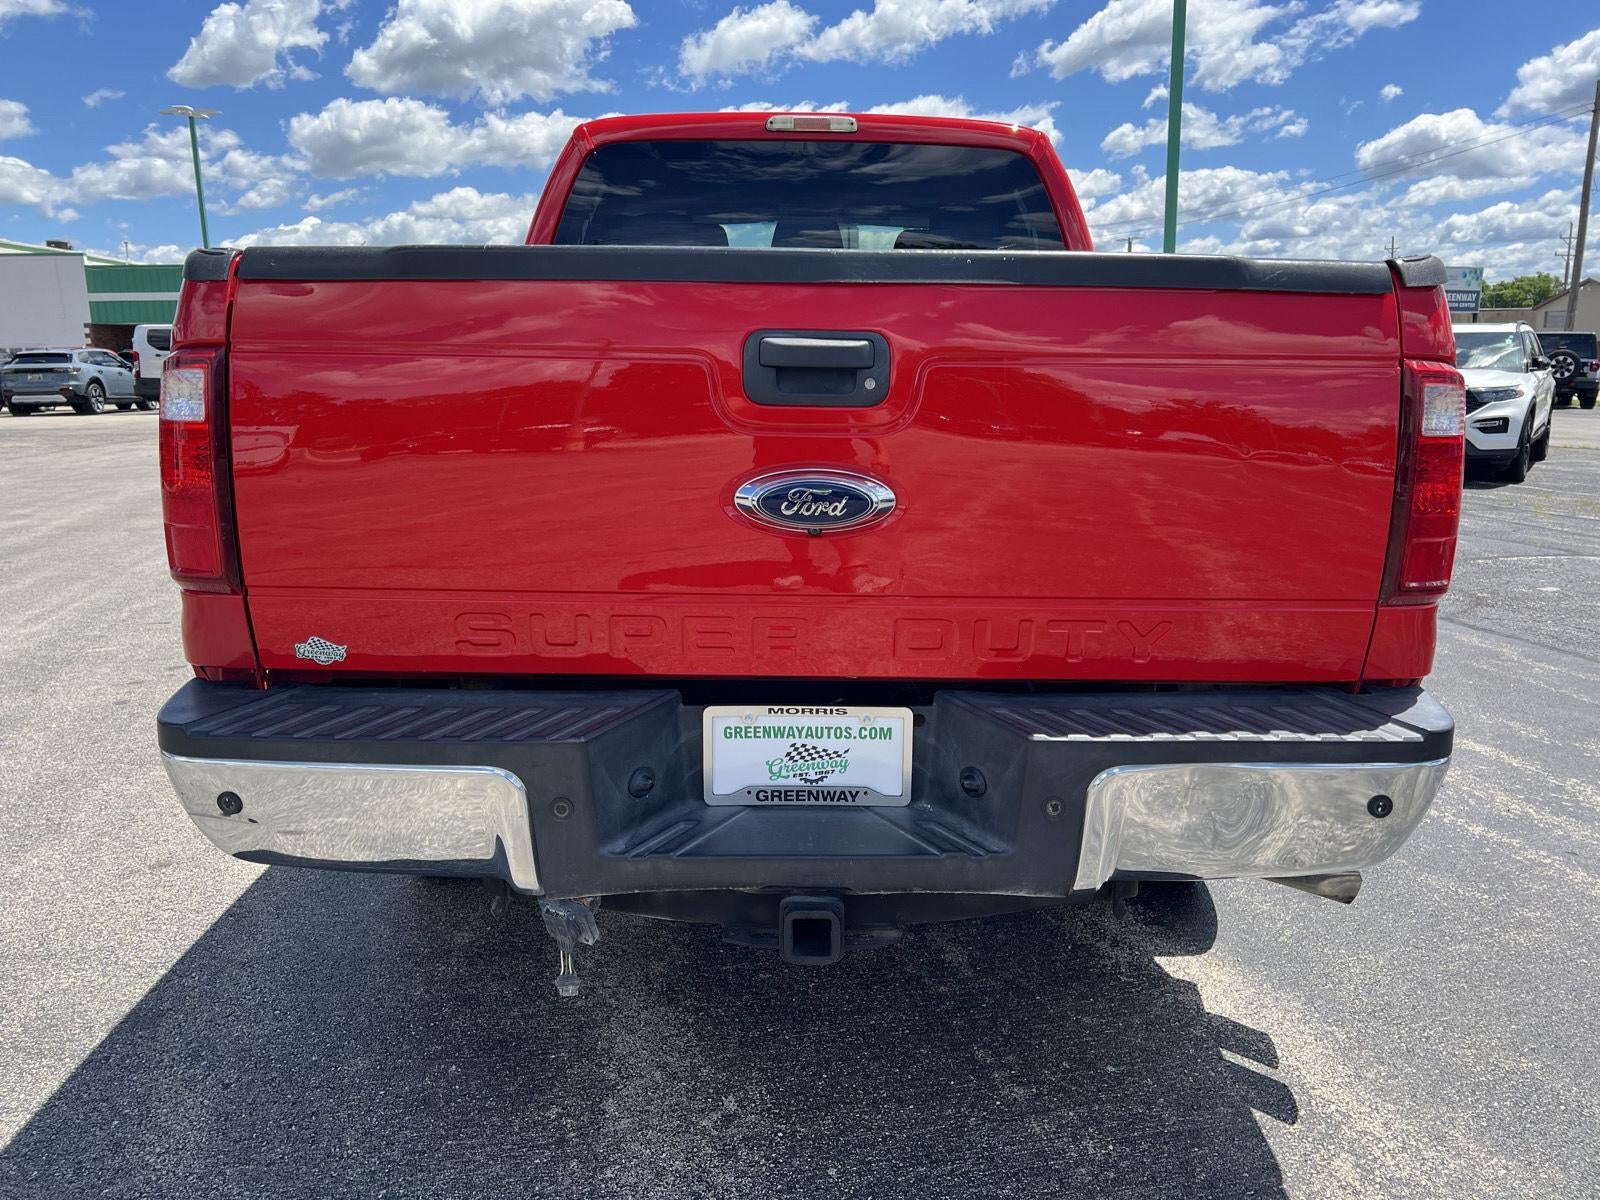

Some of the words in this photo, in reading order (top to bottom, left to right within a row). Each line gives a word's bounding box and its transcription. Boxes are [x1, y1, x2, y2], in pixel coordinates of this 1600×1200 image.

[1447, 293, 1477, 301] EENWAY
[781, 487, 849, 517] Ford
[454, 612, 809, 660] SUPER
[893, 617, 1174, 664] DUTY
[767, 707, 849, 716] MORRIS
[723, 725, 893, 741] GREENWAYAUTOS.COM
[766, 757, 850, 781] Greenway
[755, 789, 860, 803] GREENWAY
